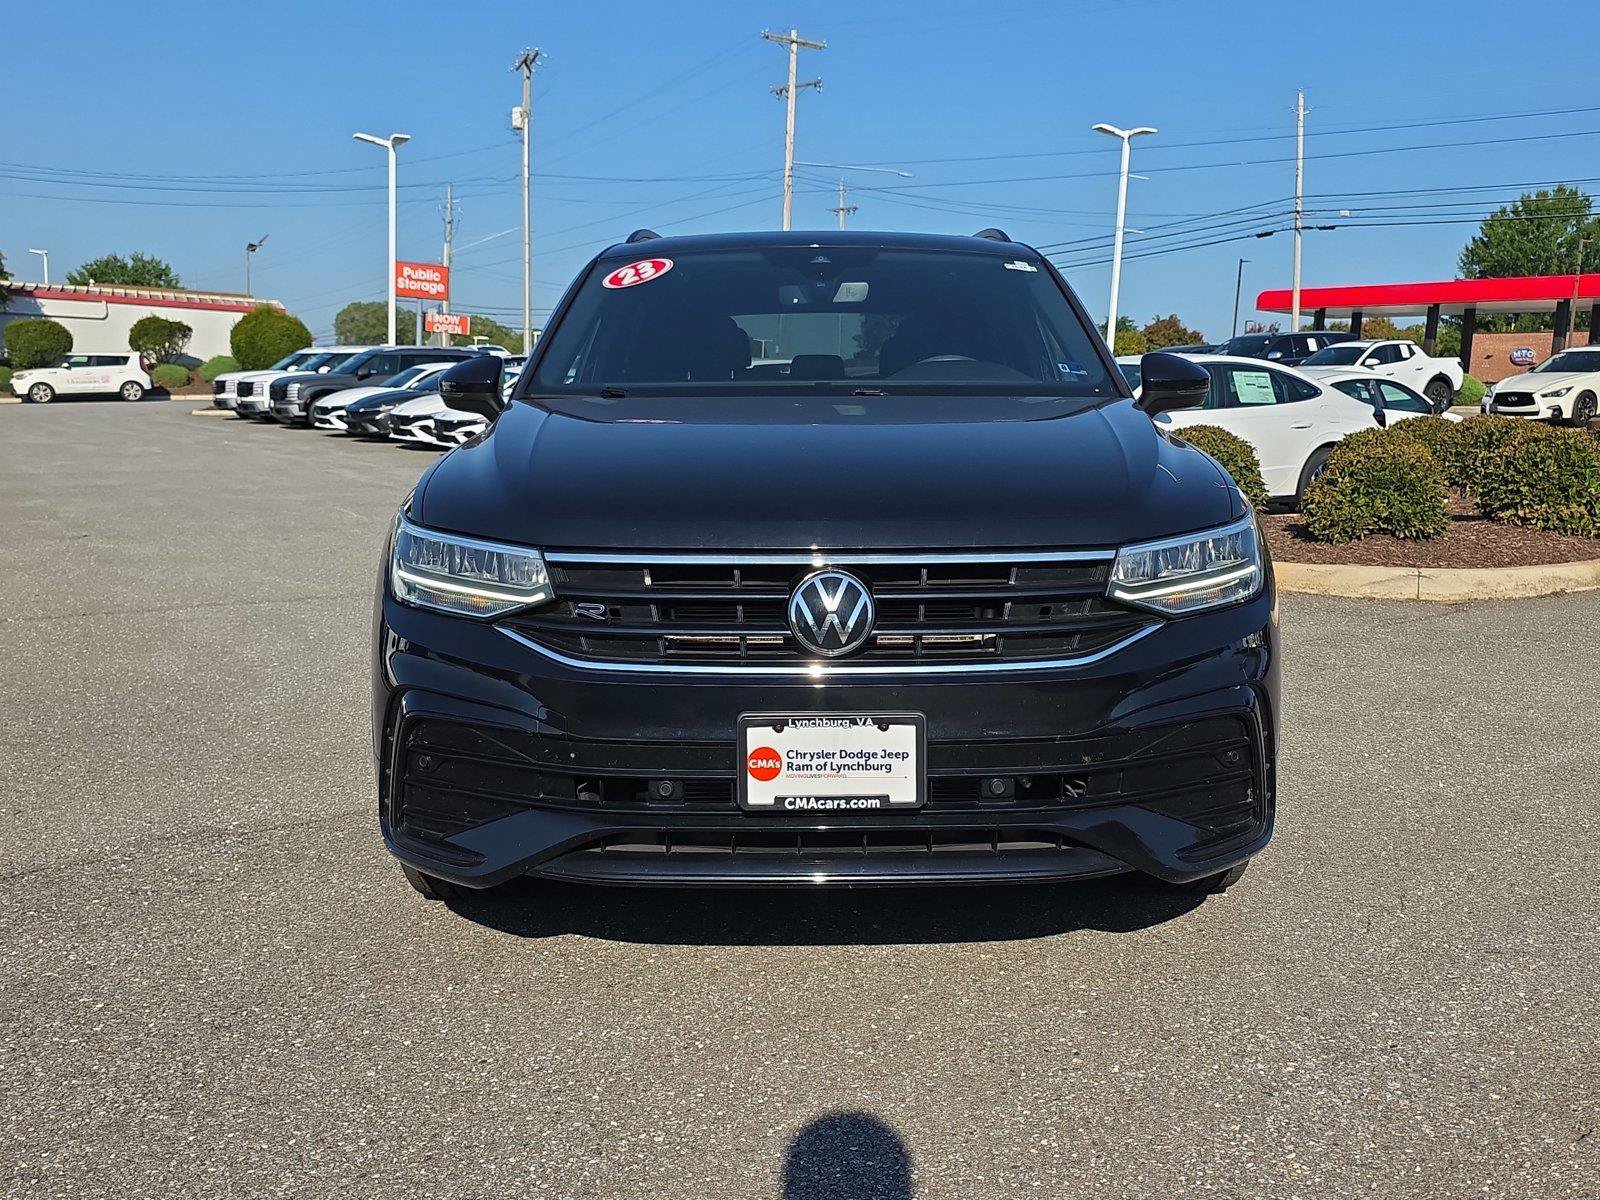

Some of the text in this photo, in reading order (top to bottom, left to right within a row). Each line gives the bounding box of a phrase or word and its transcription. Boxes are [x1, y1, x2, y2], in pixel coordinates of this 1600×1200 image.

[402, 266, 441, 282] Public
[617, 262, 656, 285] 23
[397, 277, 445, 295] Storage
[433, 313, 461, 325] NOW
[432, 323, 463, 335] OPEN
[788, 717, 874, 729] Lynchburg, VA
[786, 749, 909, 763] Chrysler Dodge Jeep
[748, 758, 781, 769] CMA's
[786, 761, 892, 774] Ram of Lynchburg
[784, 797, 881, 810] CMAcars.com
